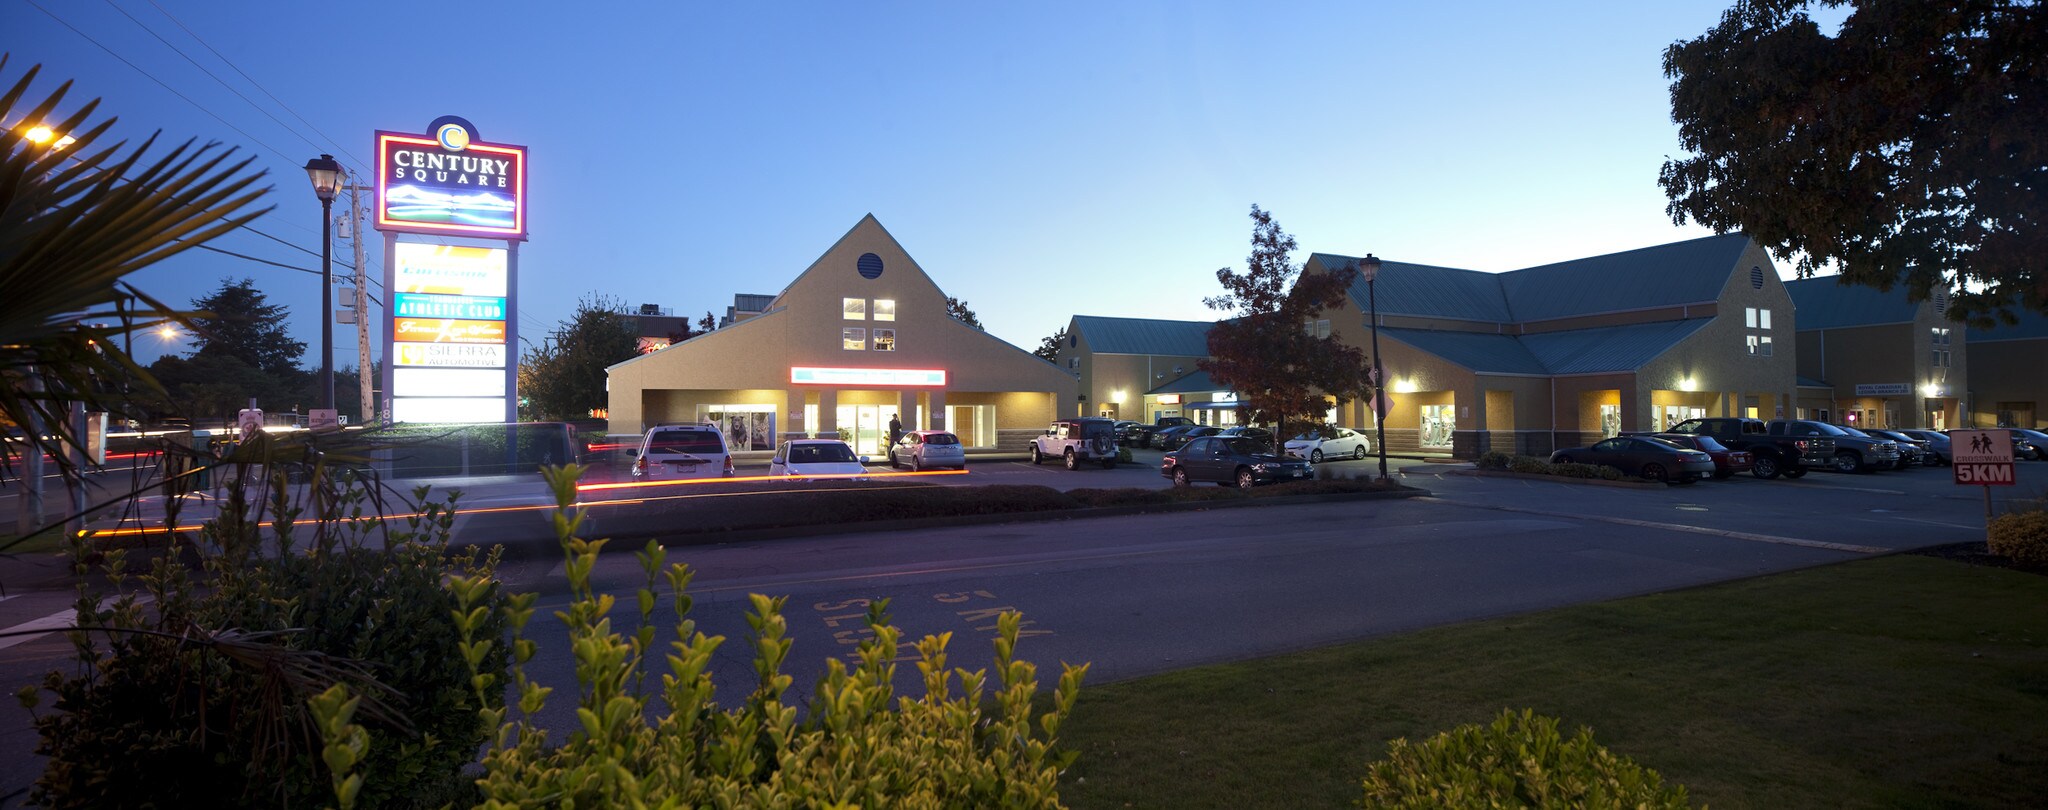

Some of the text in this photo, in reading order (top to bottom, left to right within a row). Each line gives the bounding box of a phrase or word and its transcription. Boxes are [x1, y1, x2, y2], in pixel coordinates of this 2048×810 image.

[441, 127, 462, 148] C
[394, 150, 509, 176] CENTURY
[396, 167, 507, 188] SQUARE
[400, 302, 501, 318] ATHLETIC CLUB
[429, 345, 497, 357] SIERRA
[429, 358, 497, 366] AUTOMOTIVE
[1957, 464, 2012, 482] 5KM
